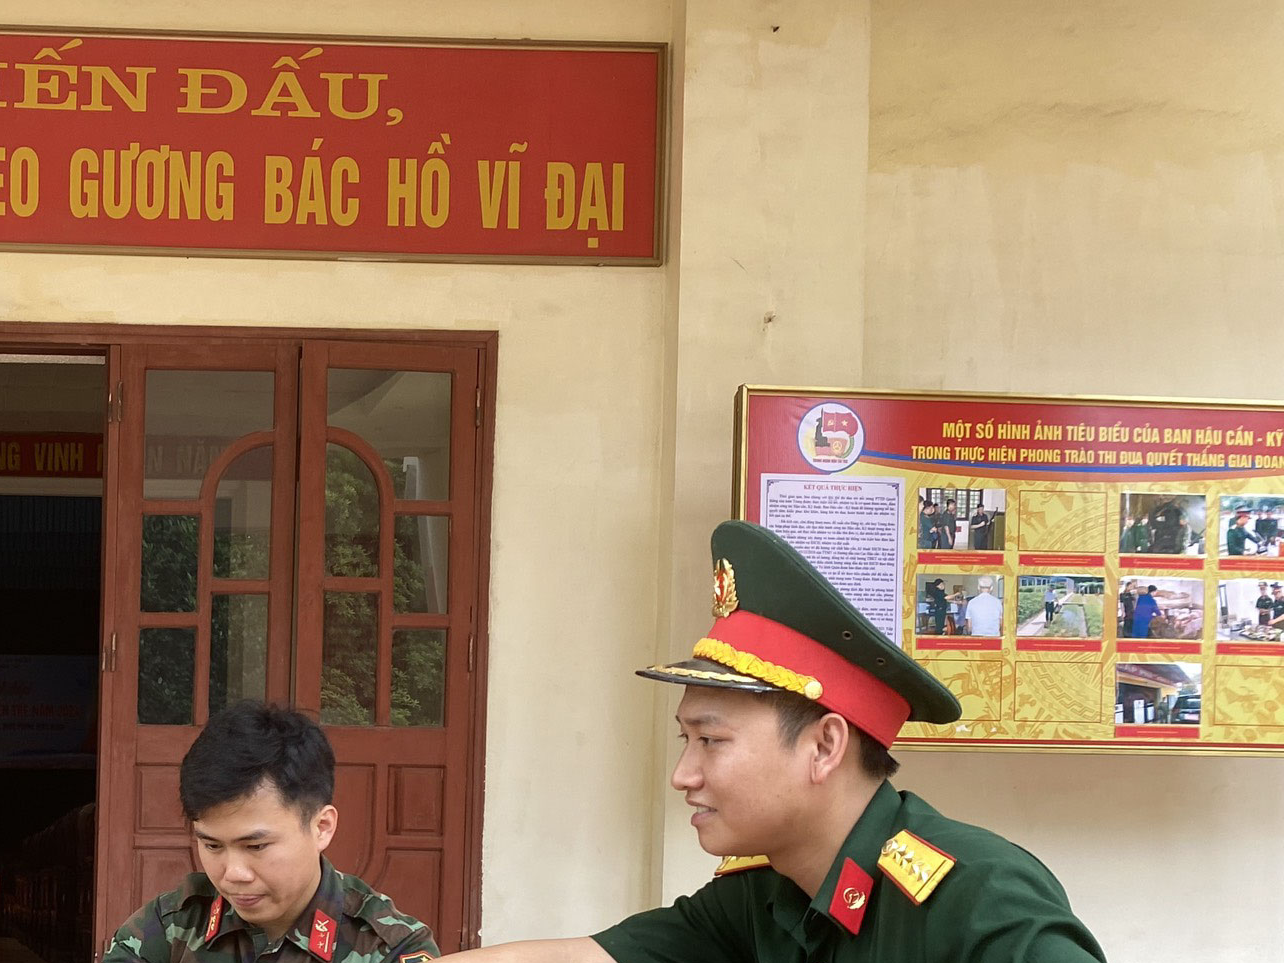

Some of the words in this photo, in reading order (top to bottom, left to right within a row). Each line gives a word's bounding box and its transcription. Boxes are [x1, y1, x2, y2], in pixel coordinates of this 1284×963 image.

[176, 46, 404, 126] ĐẤU,
[69, 142, 235, 222] GƯƠNG
[264, 138, 360, 227] BÁC
[387, 133, 451, 229] HỒ
[477, 141, 528, 230] VĨ
[544, 161, 625, 249] ĐẠI
[942, 419, 973, 442] MỘT
[975, 417, 995, 440] SỐ
[997, 420, 1031, 441] HÌNH
[1034, 419, 1063, 442] ẢNH
[1066, 422, 1095, 442] TIÊU
[1133, 422, 1160, 444] CỦA
[1163, 428, 1192, 445] BAN
[33, 442, 84, 472] VINH
[911, 445, 951, 461] TRONG
[953, 446, 985, 464] THỰC
[987, 445, 1017, 465] HIỆN
[1019, 448, 1061, 463] PHONG
[1064, 447, 1095, 464] TRÀO
[1097, 450, 1117, 465] THI
[1119, 451, 1143, 465] ĐUA
[1146, 448, 1184, 467] QUYẾT
[1186, 445, 1225, 468] THẮNG
[1228, 453, 1253, 469] GIAI
